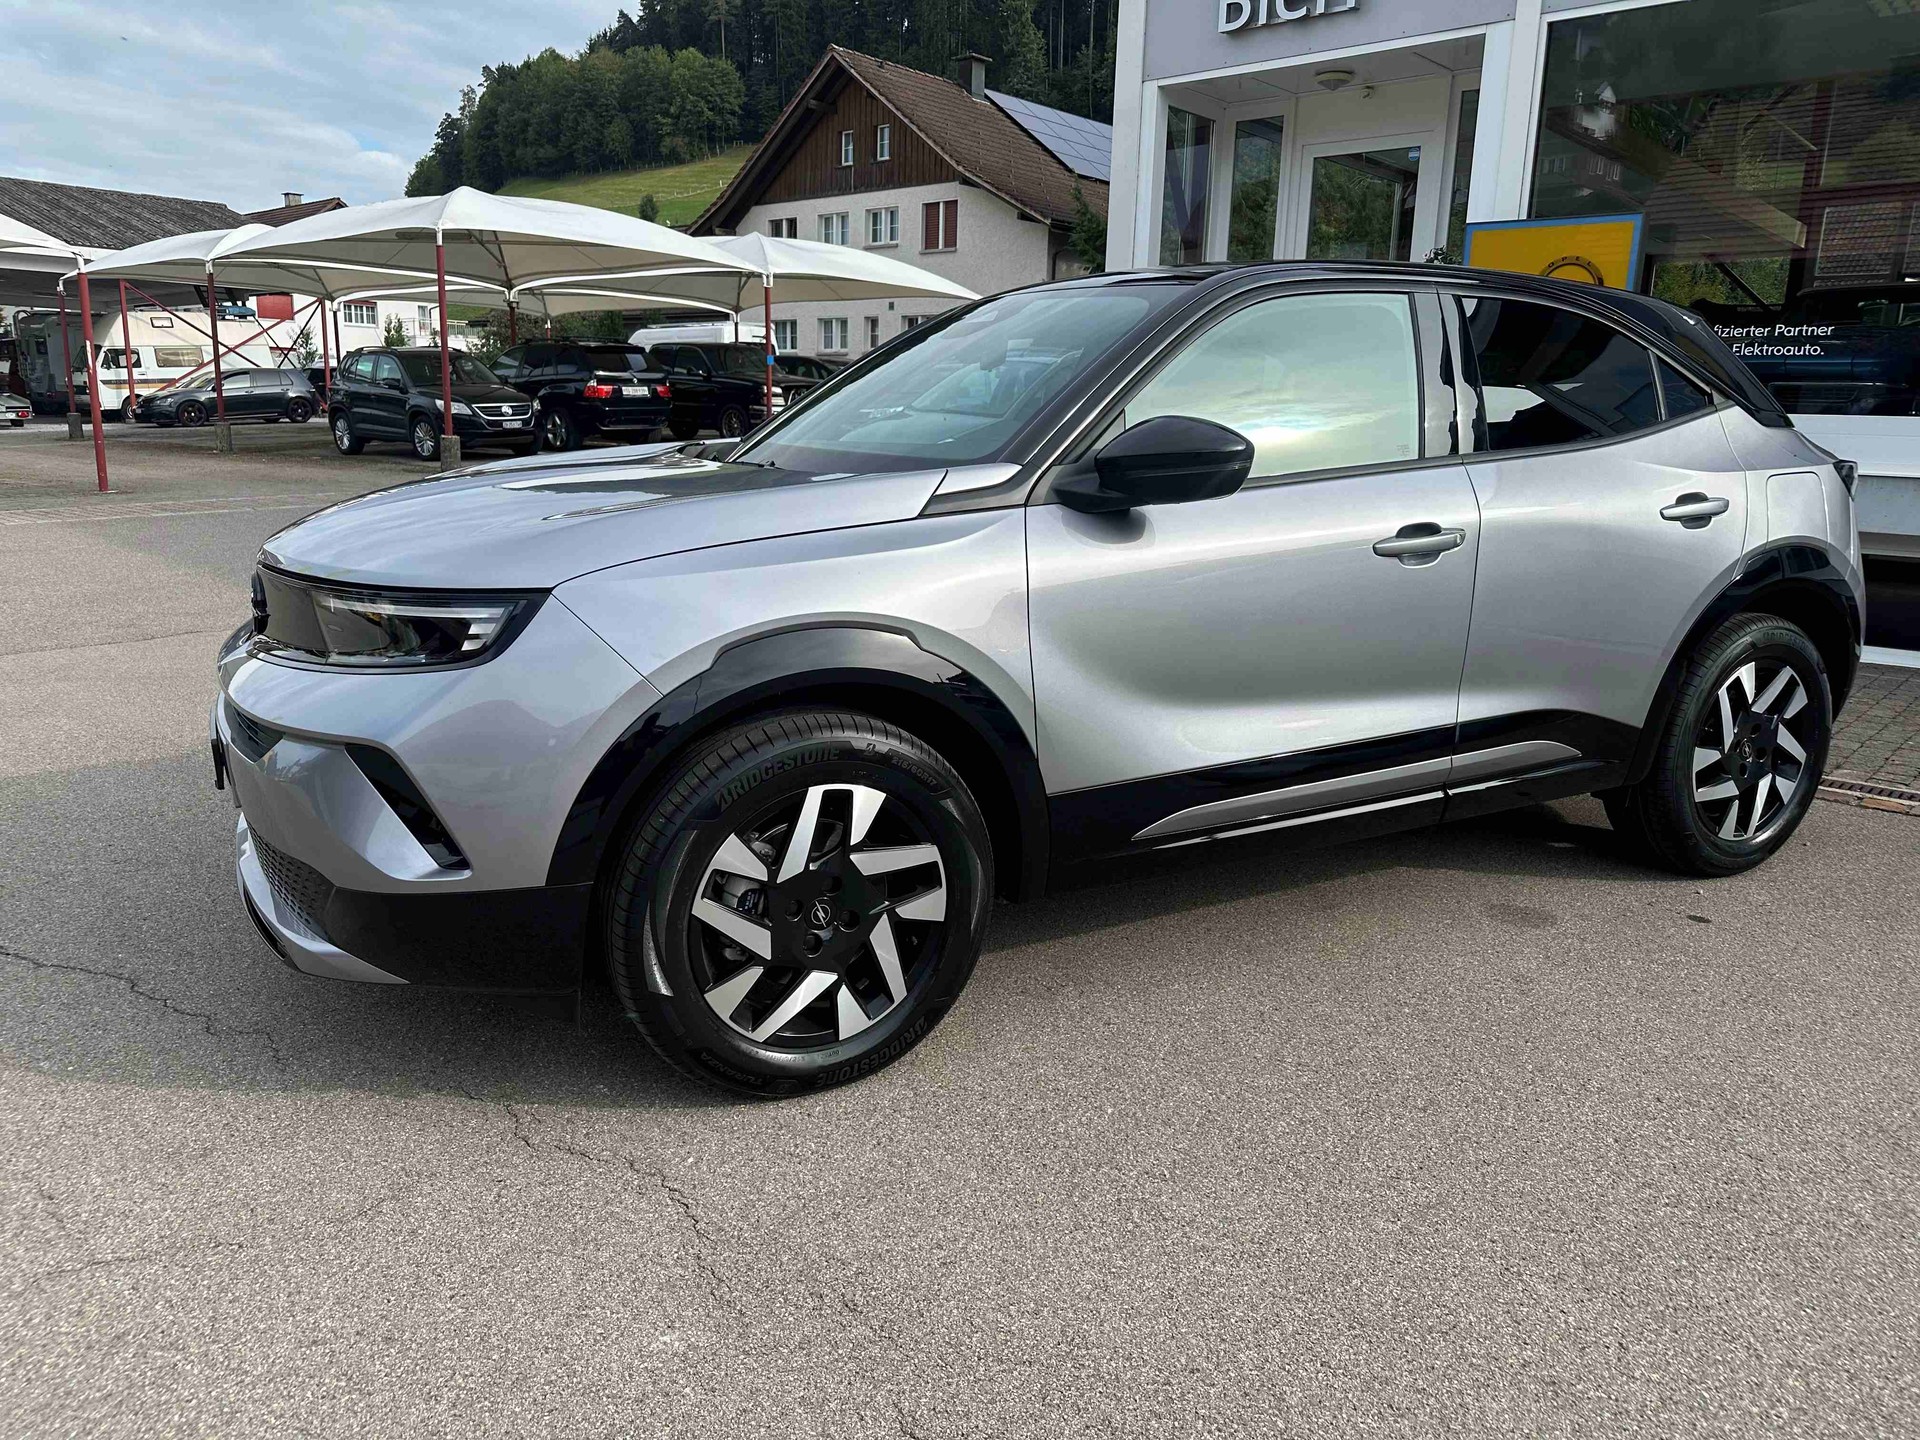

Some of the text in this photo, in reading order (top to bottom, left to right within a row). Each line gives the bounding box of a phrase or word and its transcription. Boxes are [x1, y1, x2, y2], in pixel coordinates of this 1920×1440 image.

[1547, 255, 1593, 268] OPEL
[1774, 323, 1836, 337] Partner
[1732, 342, 1825, 356] Elektroauto.
[714, 746, 841, 813] BRIDGESTONE
[814, 1014, 929, 1087] BRIDGESTONE
[699, 1050, 764, 1087] TURANZA
